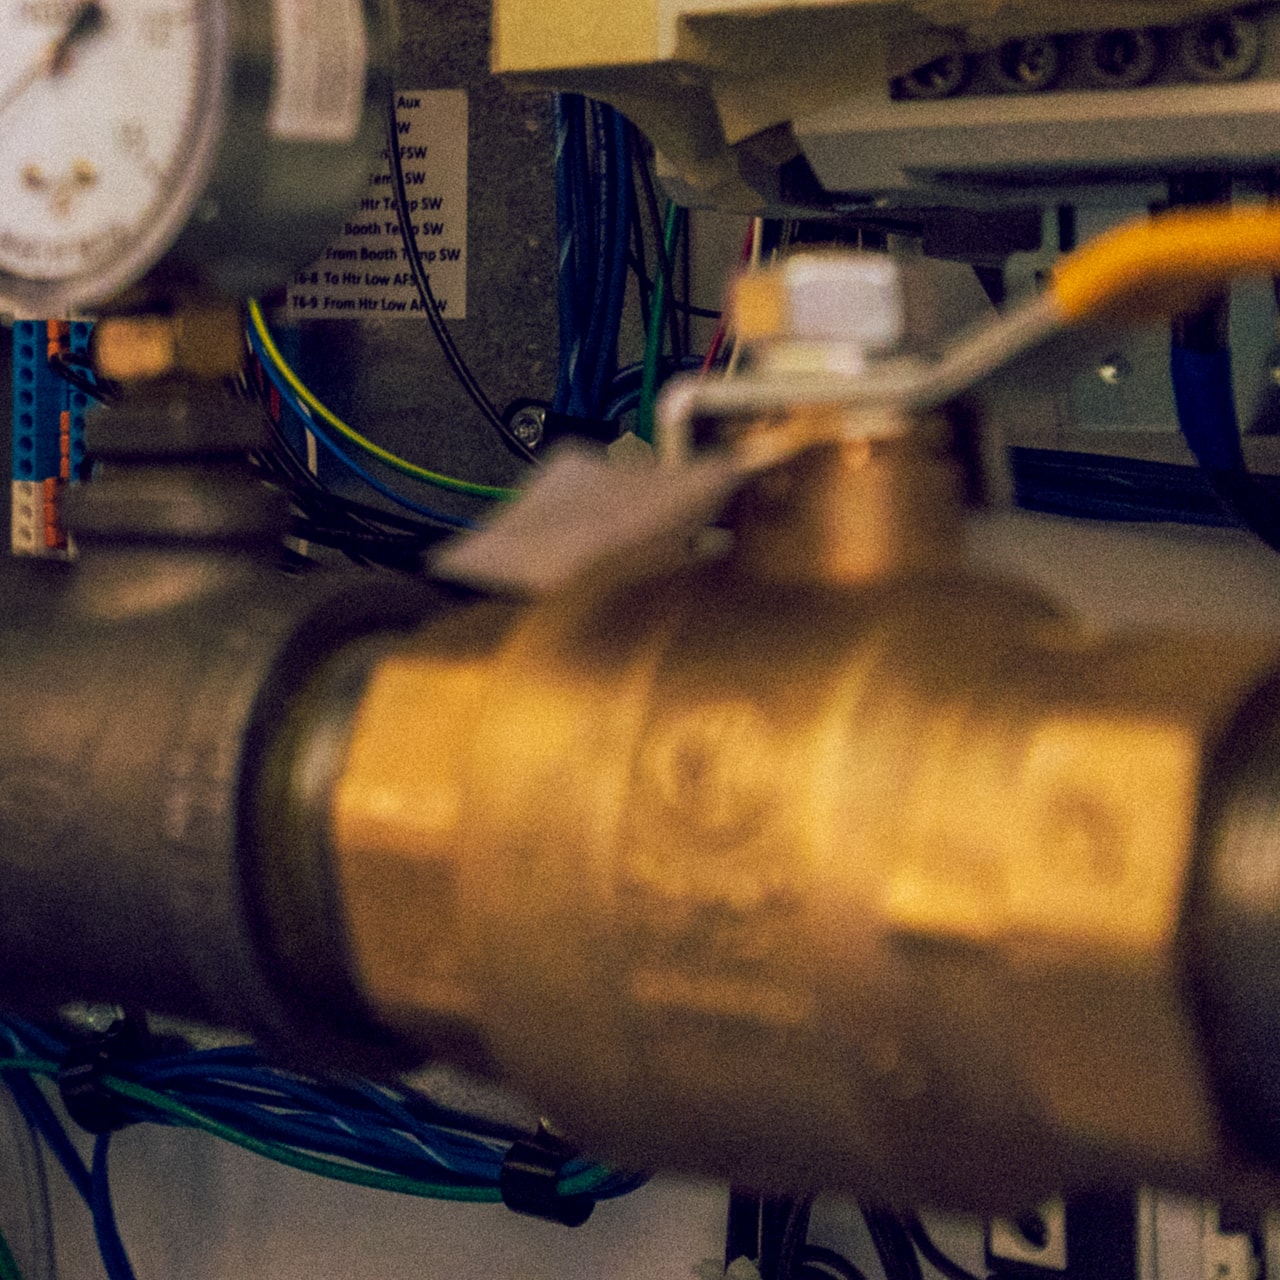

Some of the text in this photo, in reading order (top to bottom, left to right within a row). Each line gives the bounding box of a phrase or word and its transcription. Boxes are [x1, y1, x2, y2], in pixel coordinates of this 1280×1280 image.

[397, 96, 421, 109] Aux
[405, 172, 426, 185] SW
[360, 198, 380, 210] Htr
[421, 197, 443, 210] SW
[344, 223, 381, 235] Booth
[423, 222, 444, 236] SW
[326, 248, 357, 261] From
[360, 248, 397, 261] Booth
[439, 248, 461, 261] SW
[294, 272, 318, 285] T6-8
[324, 272, 339, 285] To
[342, 272, 362, 285] Htr
[365, 273, 390, 286] Low
[292, 295, 318, 308] T6-9
[323, 296, 355, 310] From
[358, 297, 378, 310] Htr
[381, 298, 406, 311] Low
